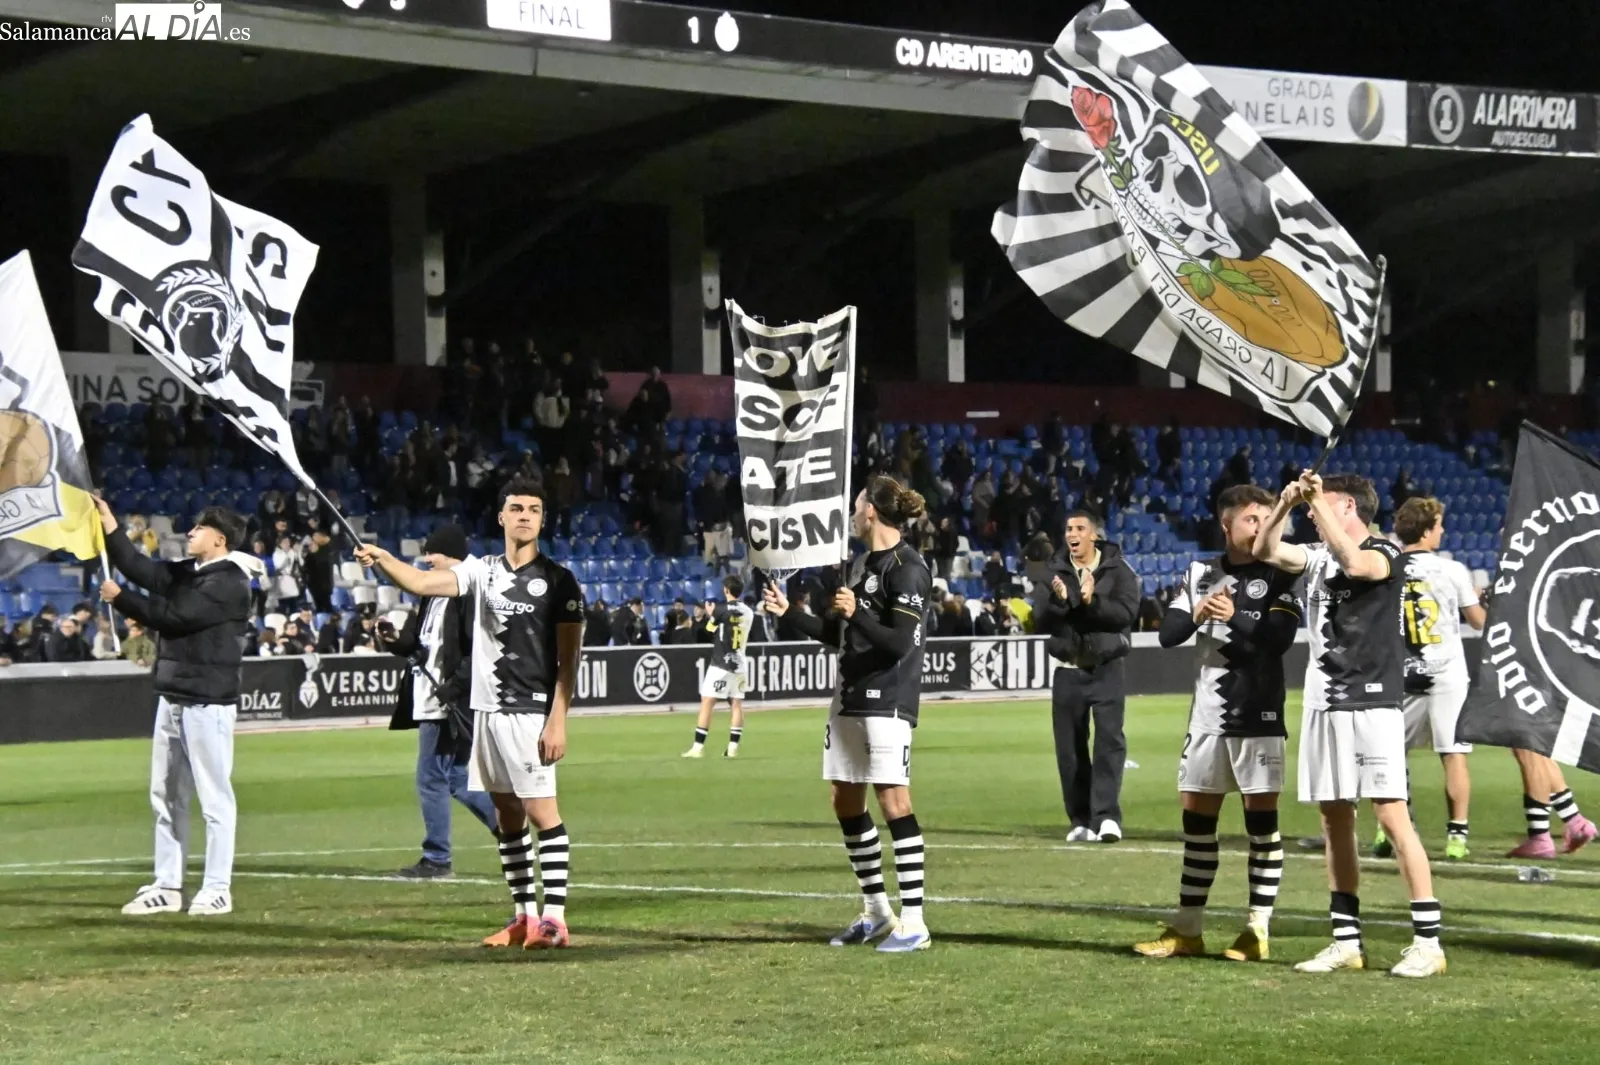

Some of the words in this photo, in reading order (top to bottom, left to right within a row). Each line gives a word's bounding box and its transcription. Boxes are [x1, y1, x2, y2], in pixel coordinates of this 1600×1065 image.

[519, 1, 586, 29] FINAL
[687, 16, 700, 44] 1
[895, 38, 924, 66] CD
[926, 41, 1033, 76] ARENTEIRO
[1267, 77, 1335, 101] GRADA
[1491, 130, 1557, 148] AUTOESCUELA
[734, 331, 841, 378] OVE
[66, 373, 128, 402] INA
[736, 384, 840, 433] SCF
[740, 447, 837, 490] ATE
[1404, 600, 1442, 644] 12
[320, 669, 405, 694] VERSU
[745, 648, 838, 693] DERACIÓN
[241, 689, 282, 710] DÍAZ
[331, 694, 399, 707] E-LEARNIN
